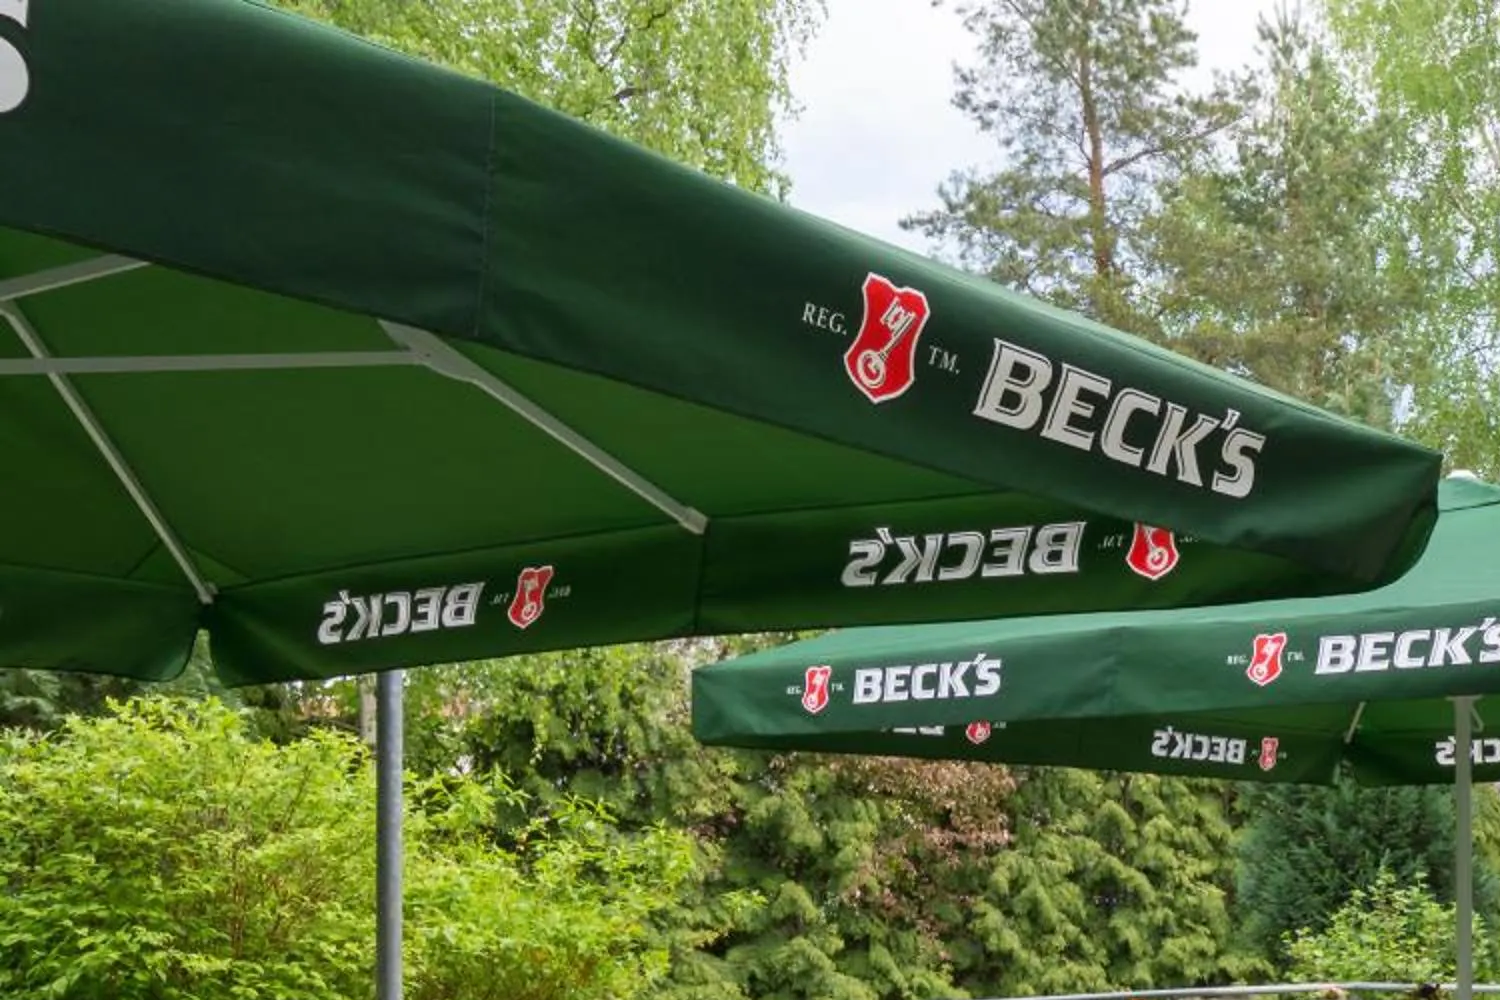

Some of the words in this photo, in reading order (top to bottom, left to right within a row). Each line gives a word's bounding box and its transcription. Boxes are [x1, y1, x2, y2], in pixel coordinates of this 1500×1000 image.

[801, 301, 848, 336] REG.
[928, 344, 961, 375] TM.
[973, 337, 1267, 499] BECK'S
[852, 652, 1002, 705] BECK'S
